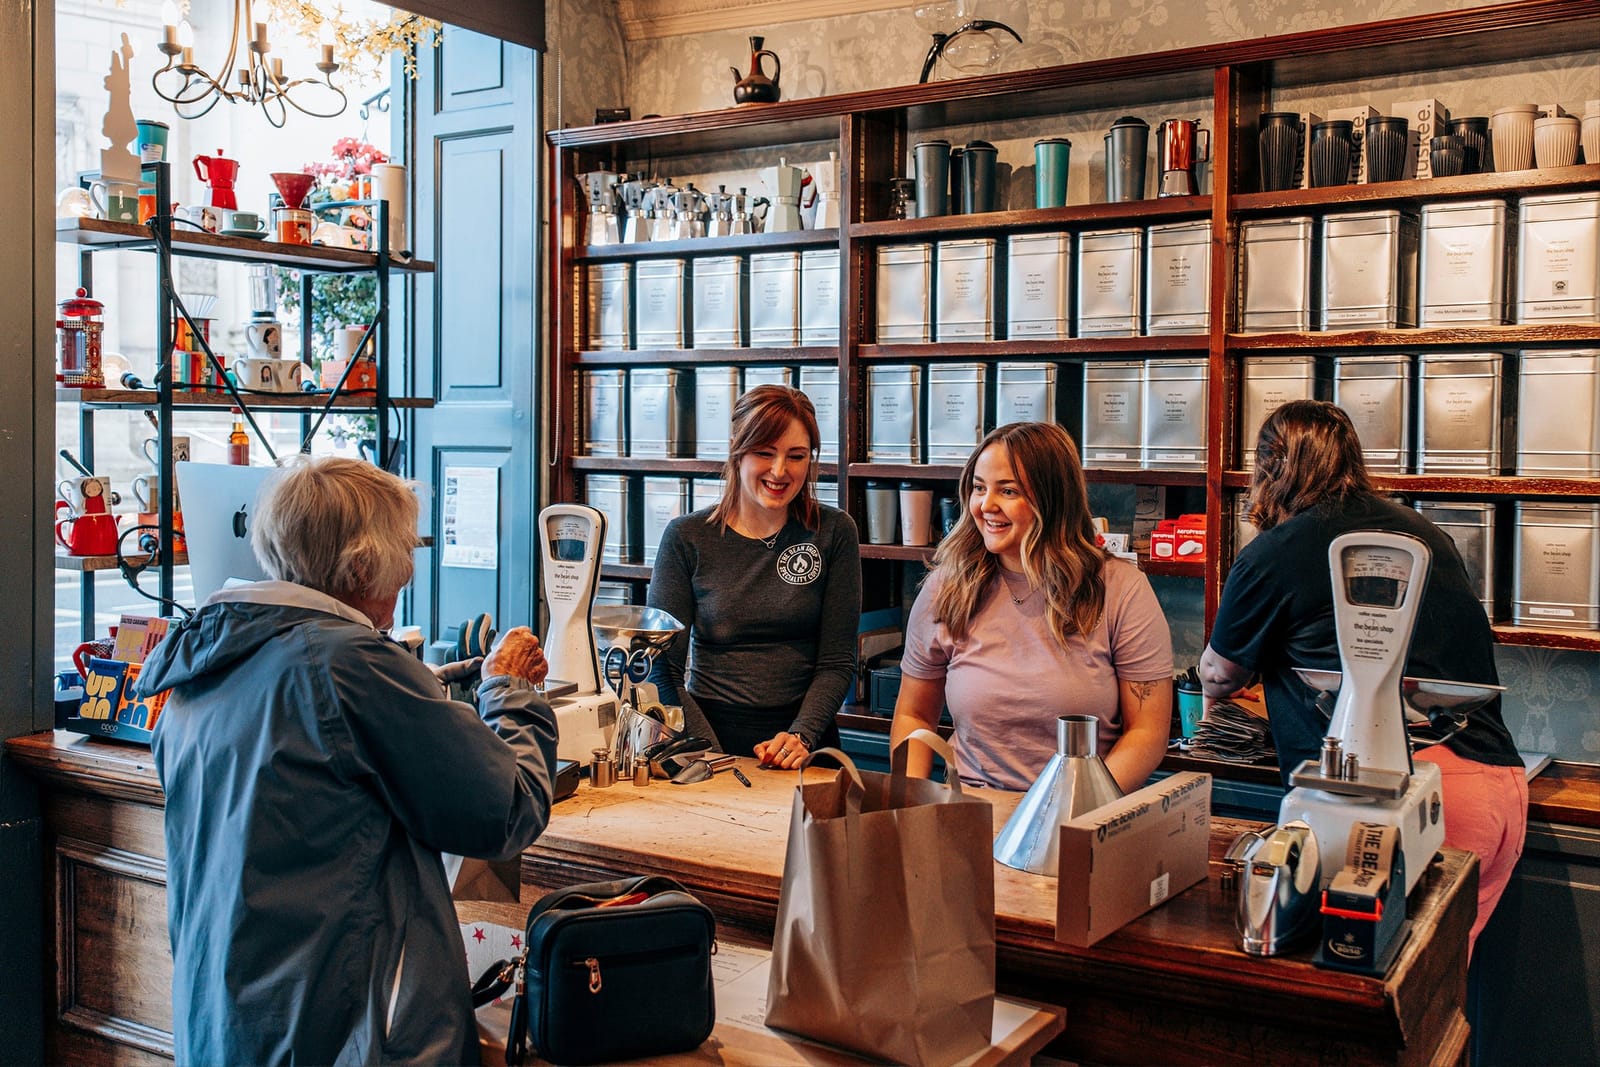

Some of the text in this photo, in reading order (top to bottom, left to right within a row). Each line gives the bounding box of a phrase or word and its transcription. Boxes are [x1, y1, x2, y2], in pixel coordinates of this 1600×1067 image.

[780, 552, 790, 564] THE
[789, 546, 805, 555] BEAN
[780, 566, 807, 583] SPECIALITY
[1380, 625, 1394, 634] shop
[1365, 829, 1383, 848] THE
